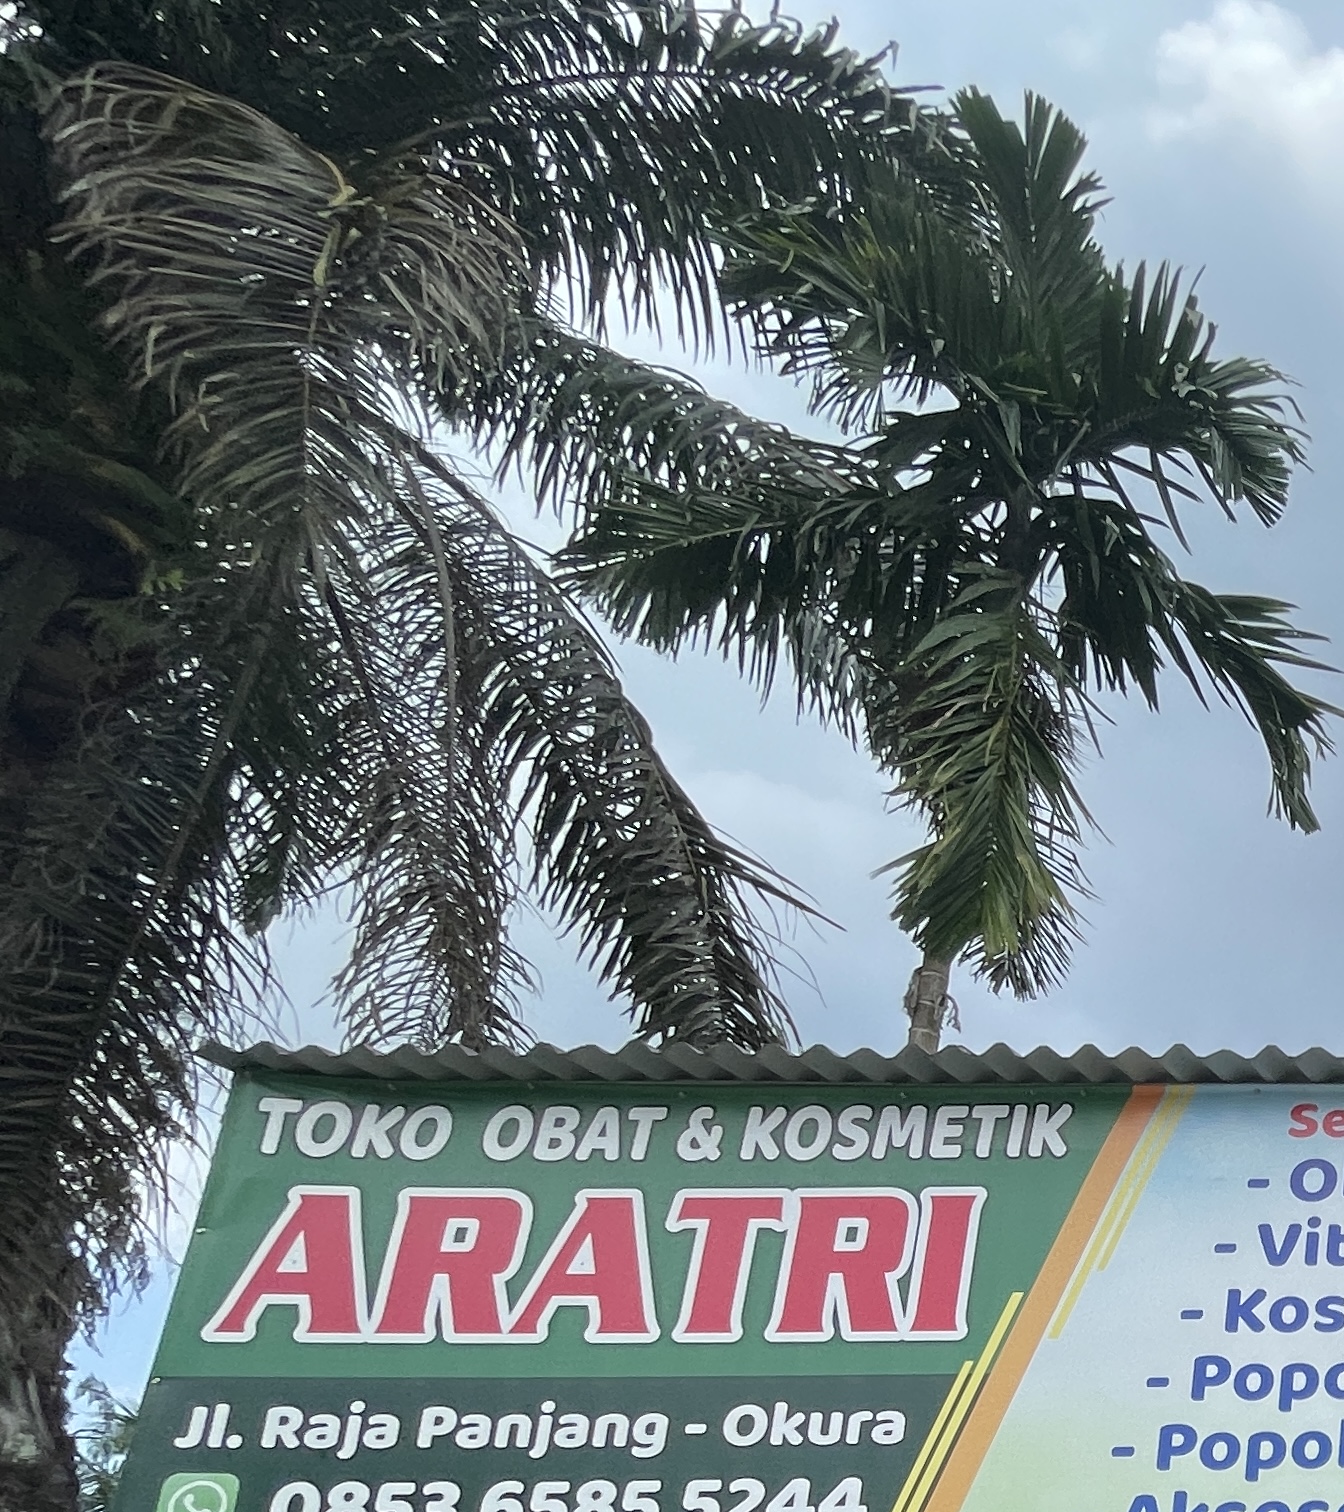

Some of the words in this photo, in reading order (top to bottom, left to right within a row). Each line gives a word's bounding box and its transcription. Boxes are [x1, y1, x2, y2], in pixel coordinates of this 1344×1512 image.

[257, 1097, 451, 1160] TOKO
[482, 1104, 668, 1163] OBAT
[677, 1104, 723, 1163] &
[740, 1102, 1075, 1161] KOSMETIK
[200, 1184, 989, 1345] ARATRI
[174, 1406, 242, 1450] Jl.
[261, 1399, 401, 1461] Raja
[417, 1399, 668, 1461] Panjang
[722, 1401, 906, 1445] Okura
